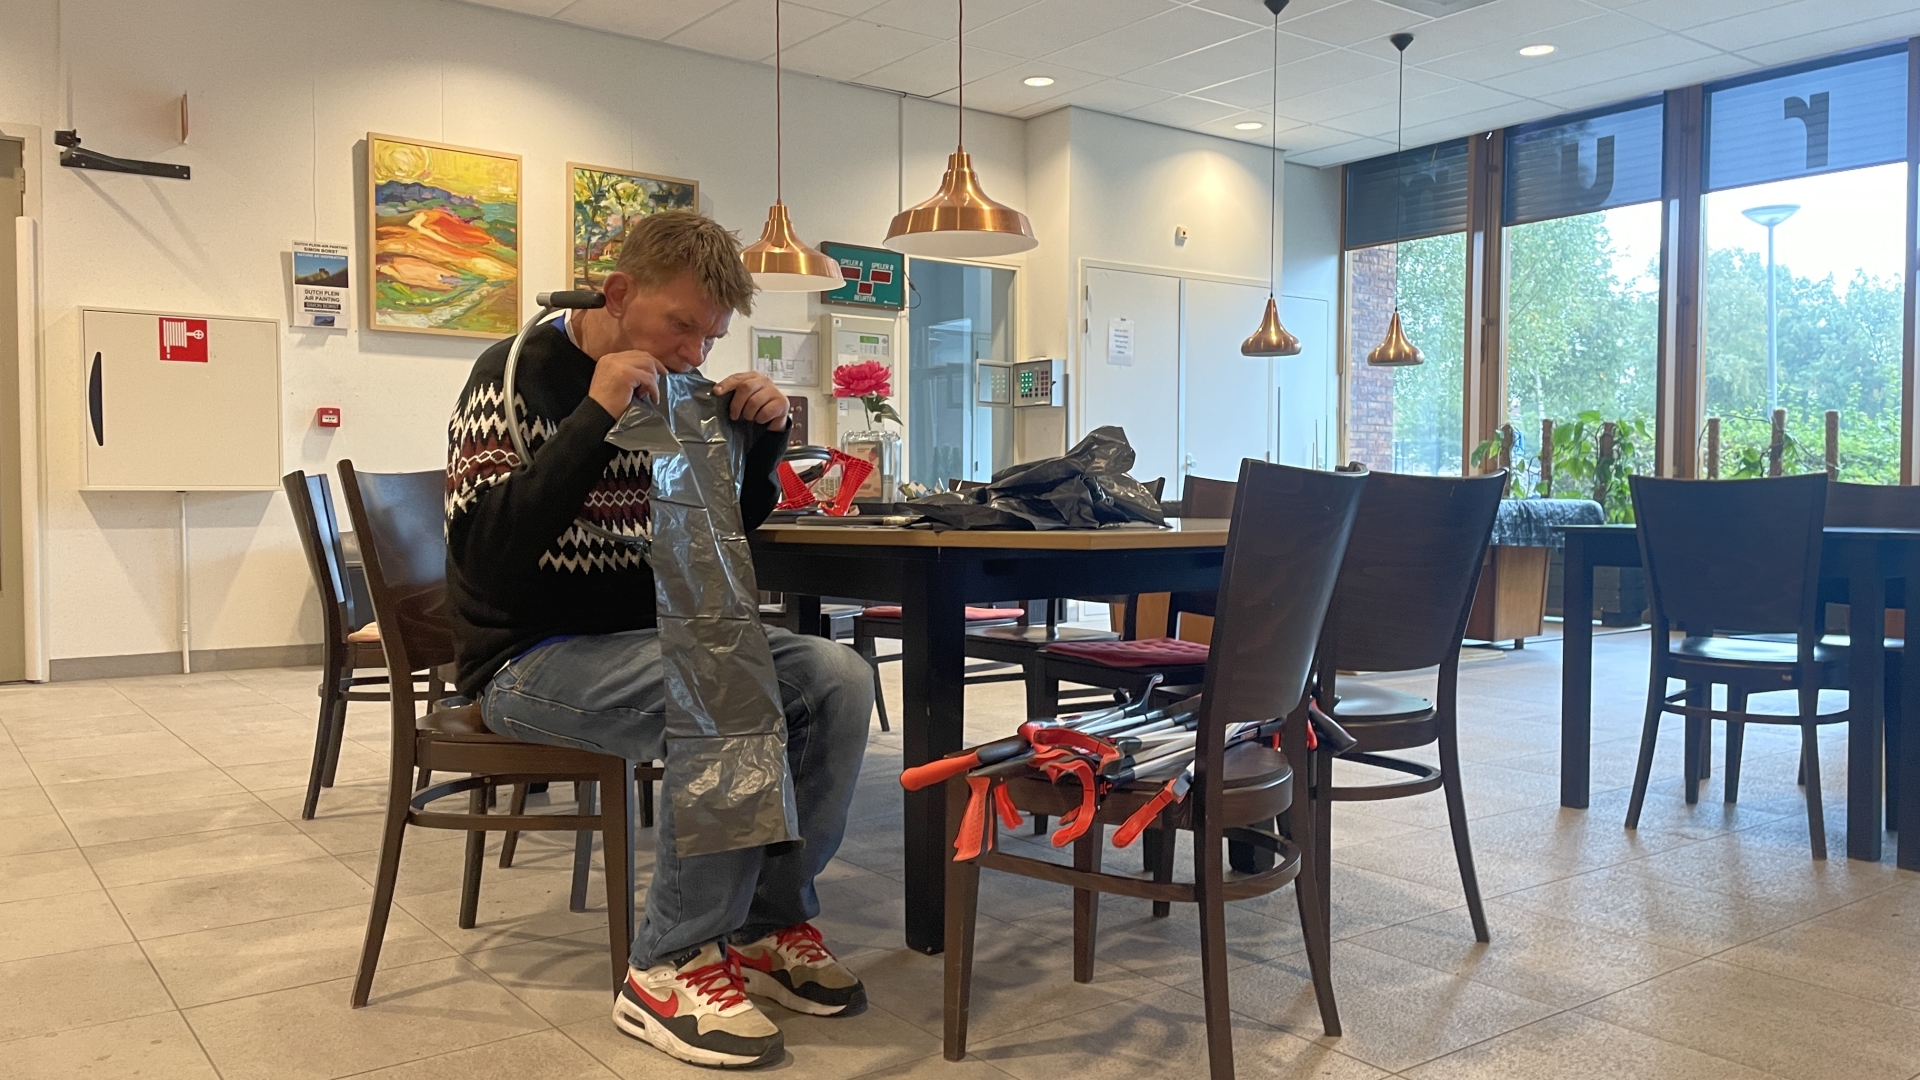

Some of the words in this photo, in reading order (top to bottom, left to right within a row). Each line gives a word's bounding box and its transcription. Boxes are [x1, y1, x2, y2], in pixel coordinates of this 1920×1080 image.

[841, 258, 859, 266] SPELER
[871, 262, 889, 270] SPELER
[854, 295, 876, 303] BEURTEN
